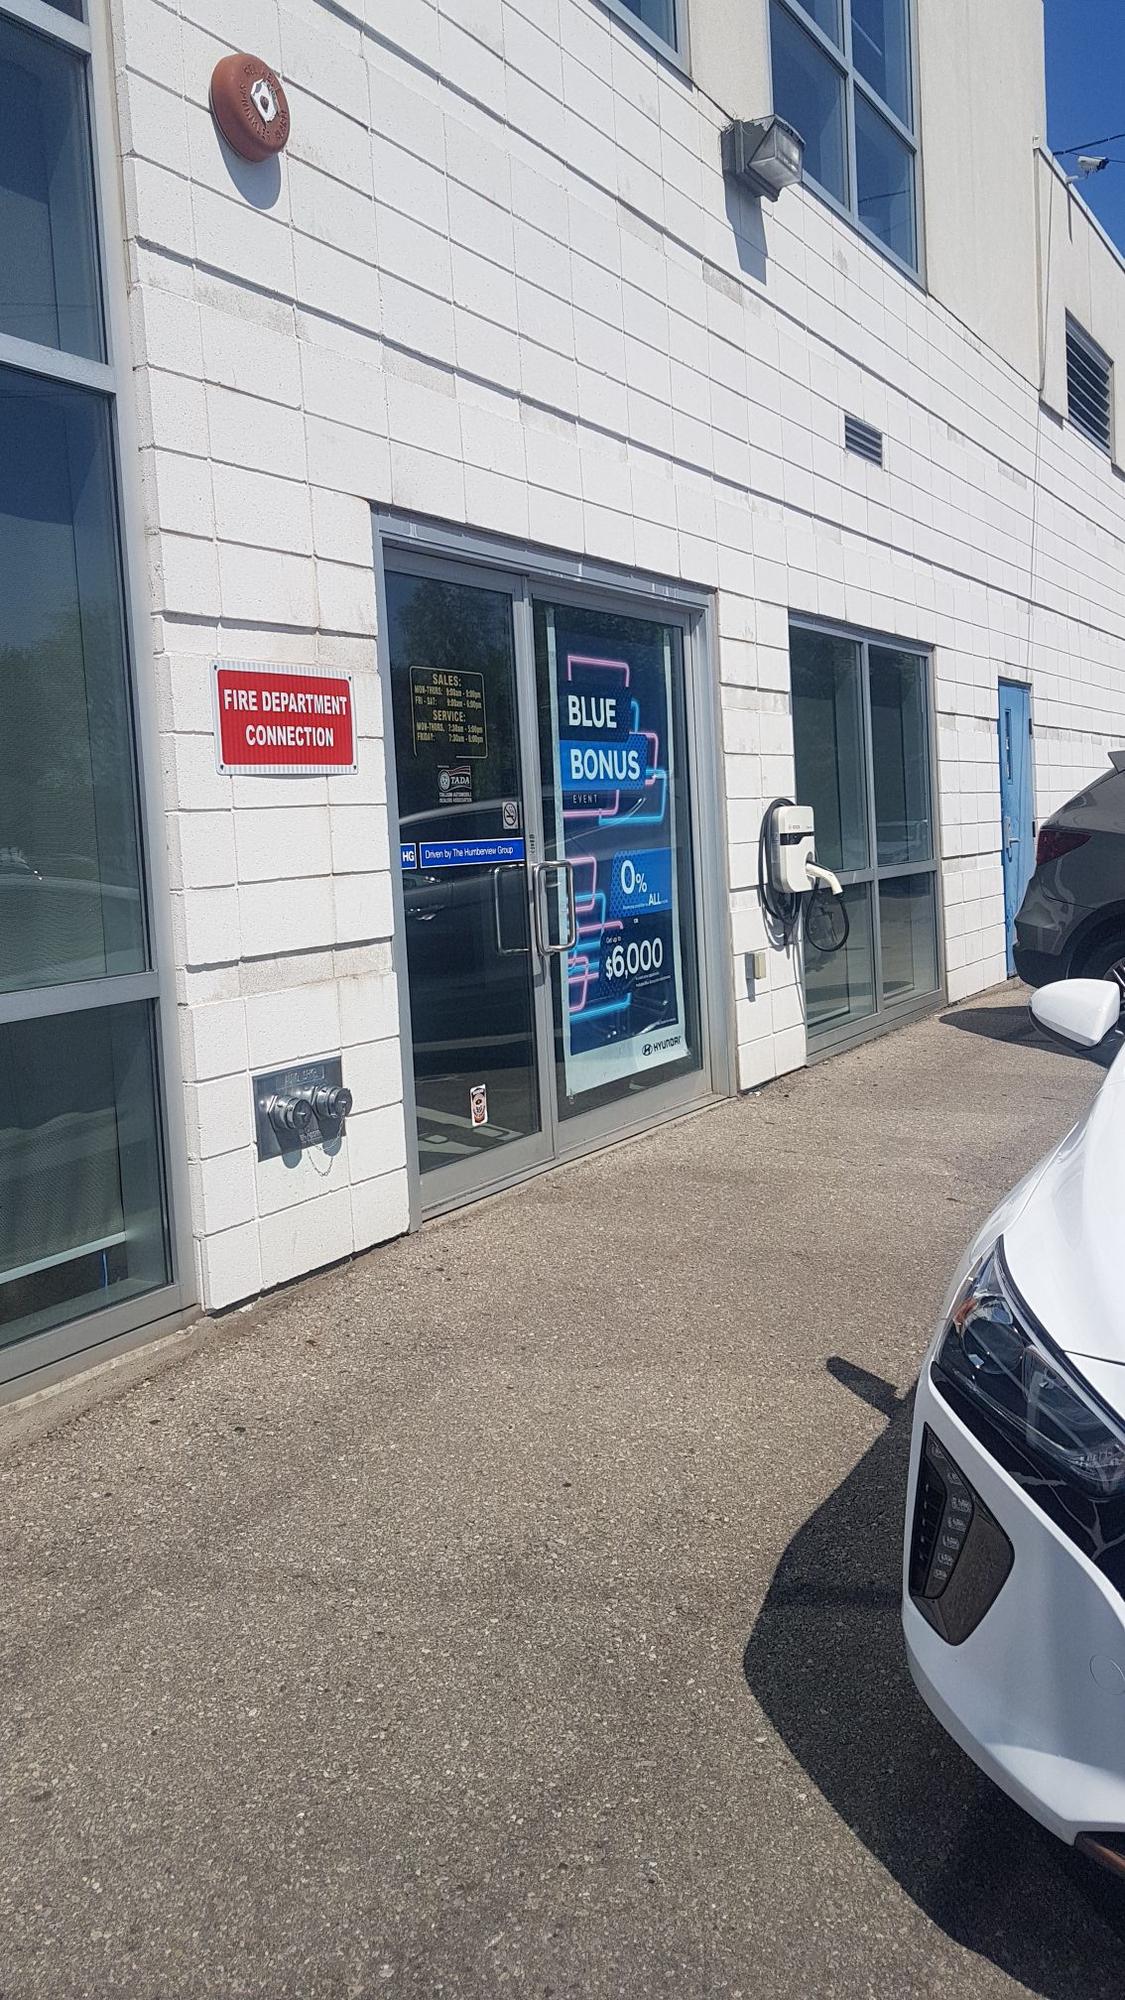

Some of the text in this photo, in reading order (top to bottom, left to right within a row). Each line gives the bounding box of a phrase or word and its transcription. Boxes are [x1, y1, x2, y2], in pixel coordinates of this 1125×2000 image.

[432, 673, 462, 687] SALES:
[223, 689, 347, 715] FIRE DEPARTMENT
[432, 709, 466, 722] SERVICE:
[567, 694, 618, 729] BLUE
[245, 724, 334, 747] CONNECTION
[570, 748, 641, 780] BONUS
[450, 776, 470, 785] TADA
[572, 794, 598, 804] EVENT
[402, 851, 415, 862] HG
[424, 845, 513, 859] Driven by The Humberview Group
[648, 892, 661, 905] ALL
[605, 937, 663, 981] $6,000
[653, 1036, 682, 1052] HYUNDAI
